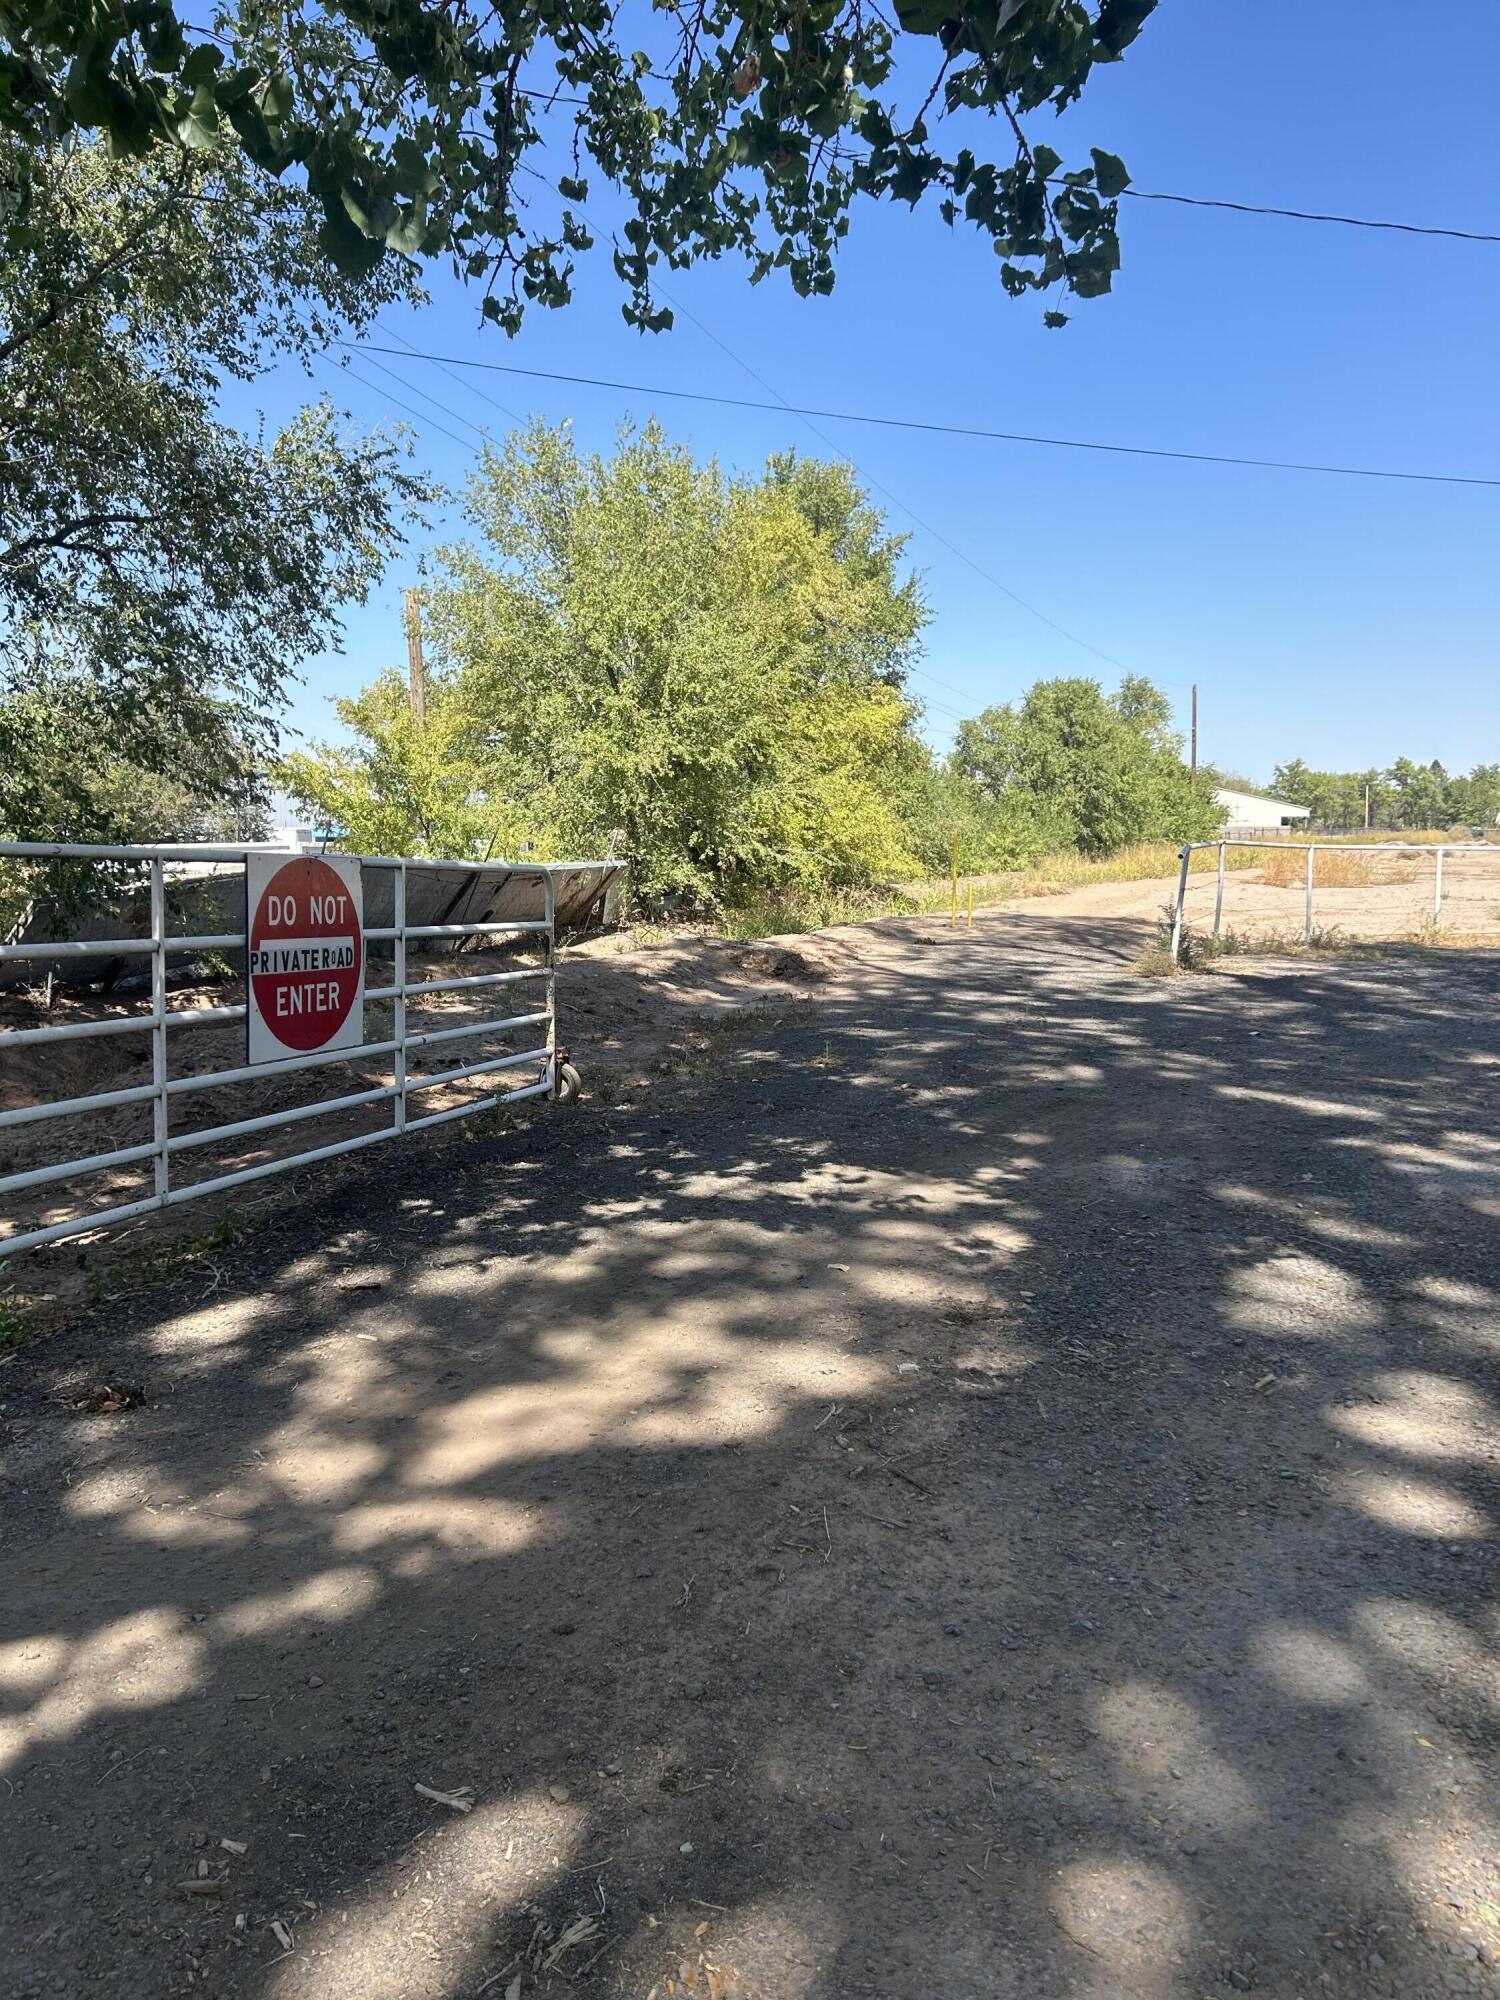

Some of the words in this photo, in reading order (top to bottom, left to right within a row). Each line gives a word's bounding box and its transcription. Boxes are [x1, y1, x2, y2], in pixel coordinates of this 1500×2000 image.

[268, 895, 297, 926] DO
[310, 895, 347, 925] NOT
[276, 981, 340, 1017] ENTER
